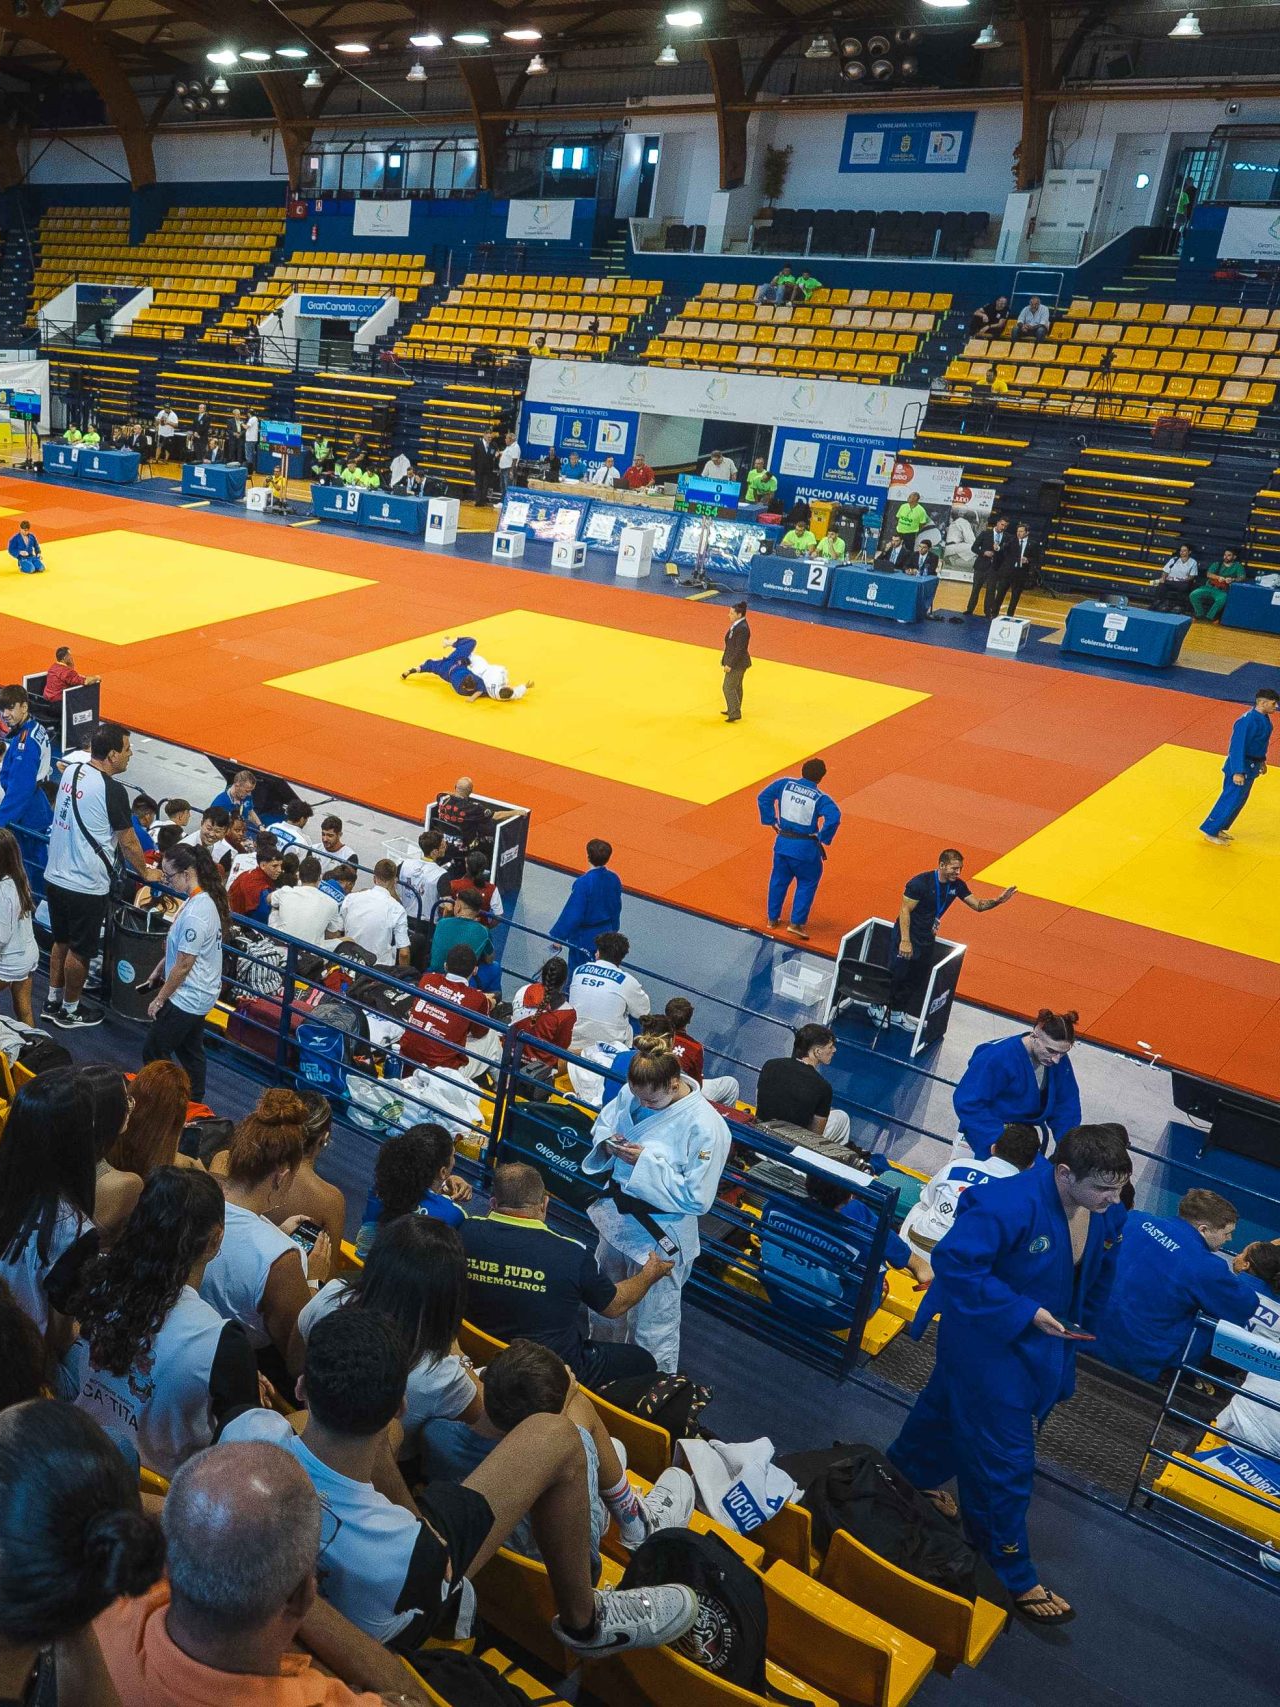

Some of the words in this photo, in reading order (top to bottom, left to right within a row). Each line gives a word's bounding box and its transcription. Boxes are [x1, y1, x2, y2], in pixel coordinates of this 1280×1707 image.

[307, 300, 378, 314] GranCanaria.com
[811, 432, 847, 442] CONSEJERÍA
[716, 484, 723, 493] 0
[795, 486, 837, 499] MUCHO
[838, 489, 857, 502] MÁS
[857, 494, 879, 506] QUE
[348, 491, 357, 507] 3
[714, 494, 720, 502] 0
[695, 503, 719, 517] 3:54
[810, 566, 823, 587] 2
[845, 595, 867, 605] Gobierno
[1079, 637, 1106, 649] Gobierno
[1106, 641, 1113, 650] de
[1113, 642, 1139, 653] Canarias
[61, 781, 84, 800] JUO
[790, 795, 807, 806] POR
[581, 977, 606, 988] ESP
[1141, 1221, 1181, 1253] CASTANY
[503, 1264, 546, 1281] JUDO
[466, 1271, 547, 1293] ORREMOLINOS
